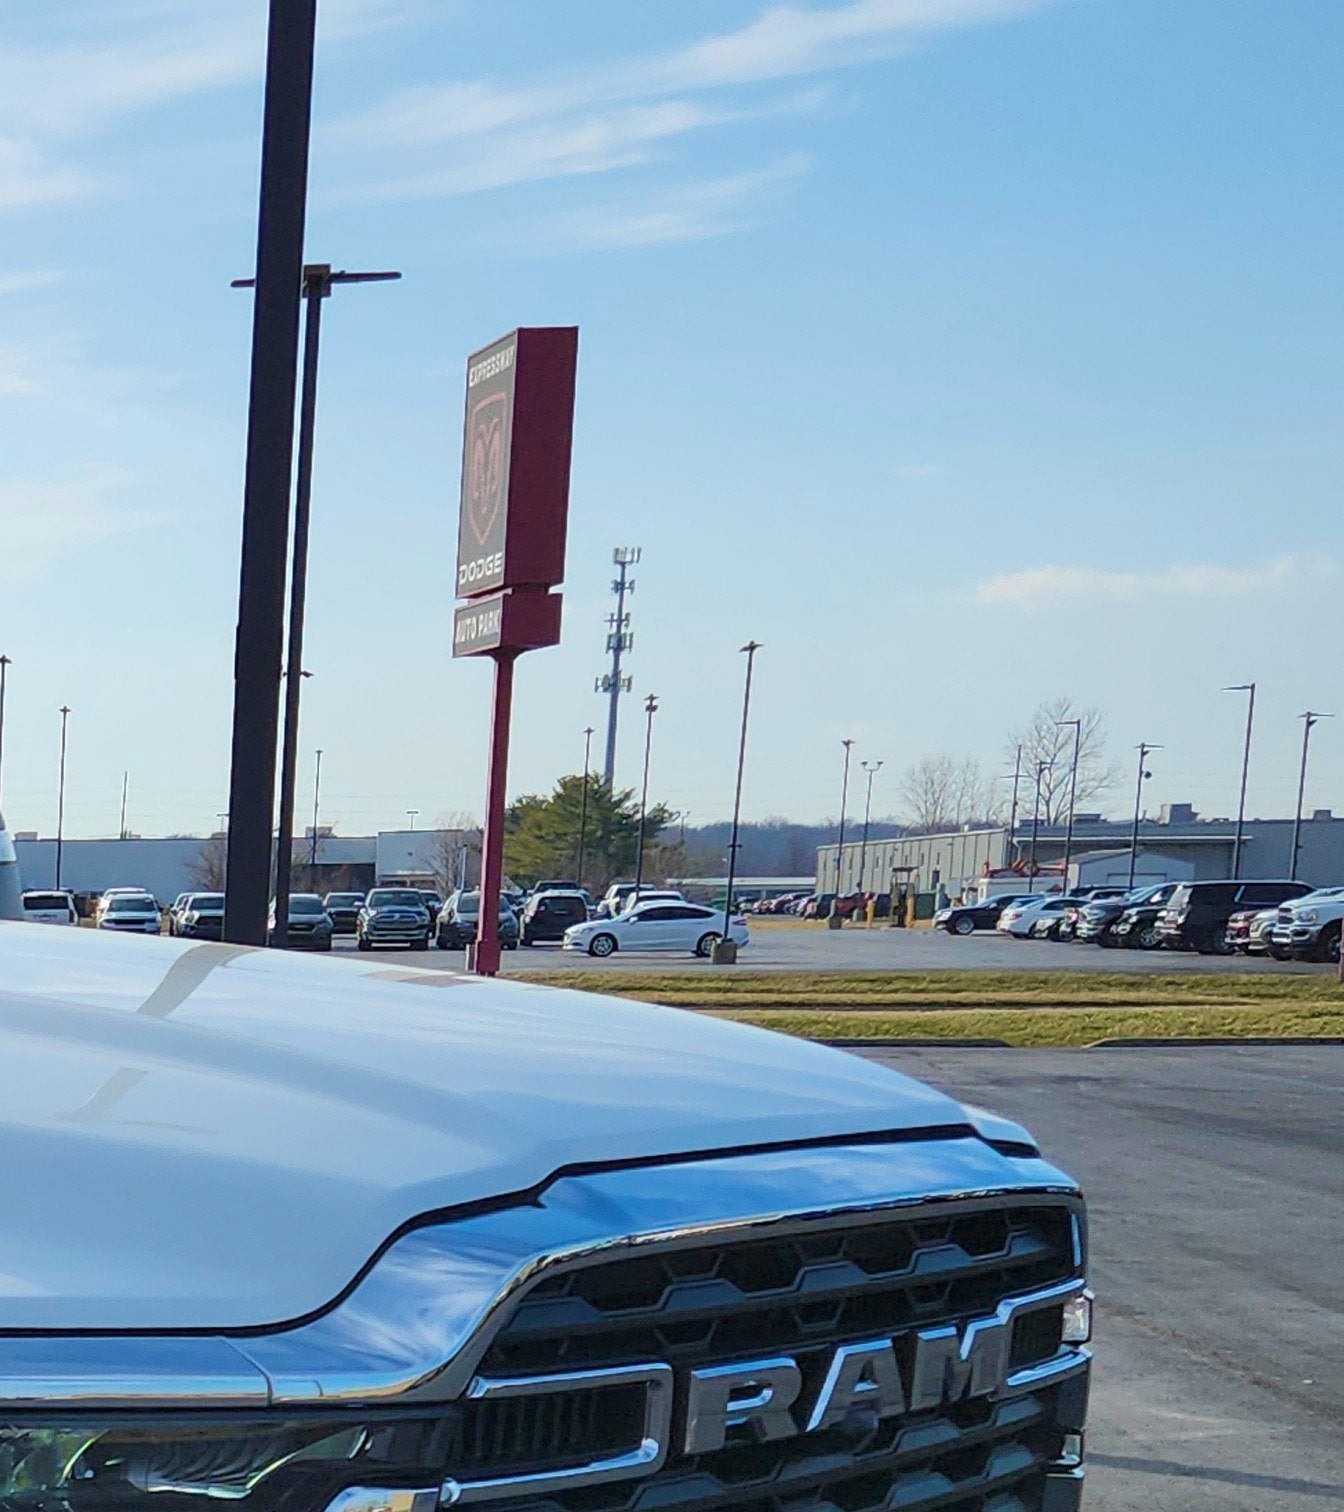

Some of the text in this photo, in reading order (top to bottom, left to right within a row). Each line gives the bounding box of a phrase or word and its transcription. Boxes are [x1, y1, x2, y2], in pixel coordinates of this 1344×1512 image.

[469, 344, 516, 388] EXPRESSWAY
[458, 551, 503, 585] DODGE
[456, 609, 501, 644] AUTO PARK
[683, 1315, 1010, 1455] RAM
